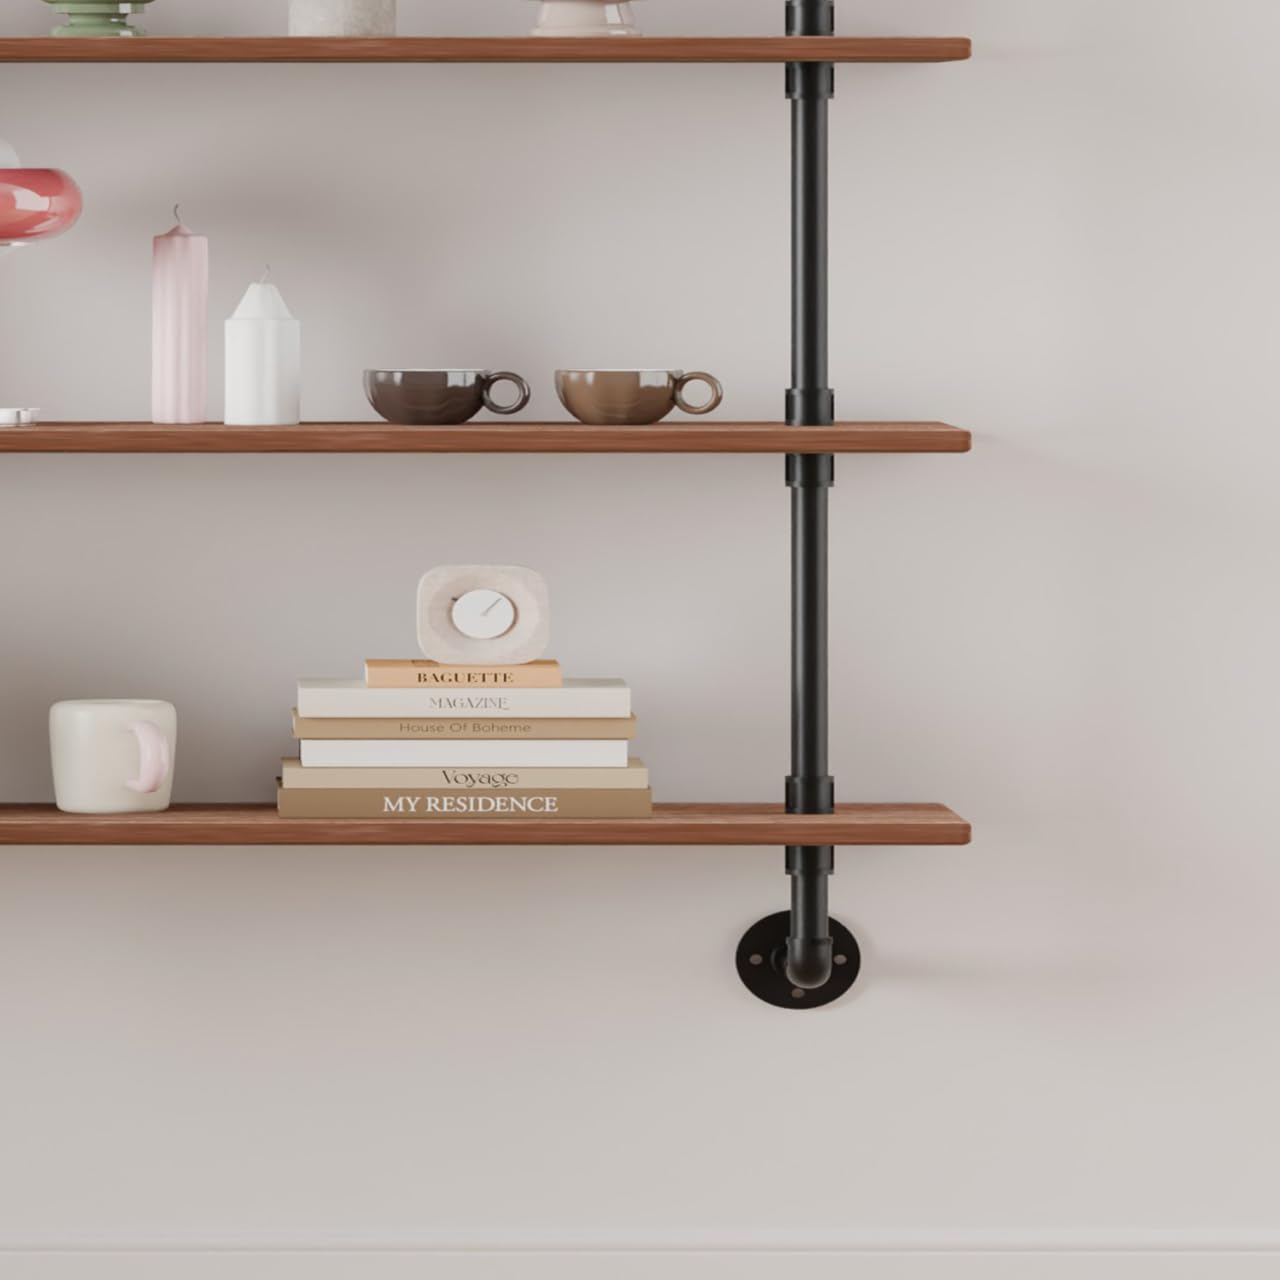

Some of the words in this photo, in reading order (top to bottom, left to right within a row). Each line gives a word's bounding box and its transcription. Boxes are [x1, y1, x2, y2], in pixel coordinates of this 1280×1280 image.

[417, 672, 514, 683] BAGUETTE
[429, 697, 510, 710] MAGAZINE
[400, 723, 445, 733] House
[449, 723, 468, 733] Of
[472, 723, 532, 733] Boheme
[442, 770, 519, 787] Voyage
[383, 796, 421, 812] MY
[426, 796, 558, 812] RESIDENCE
